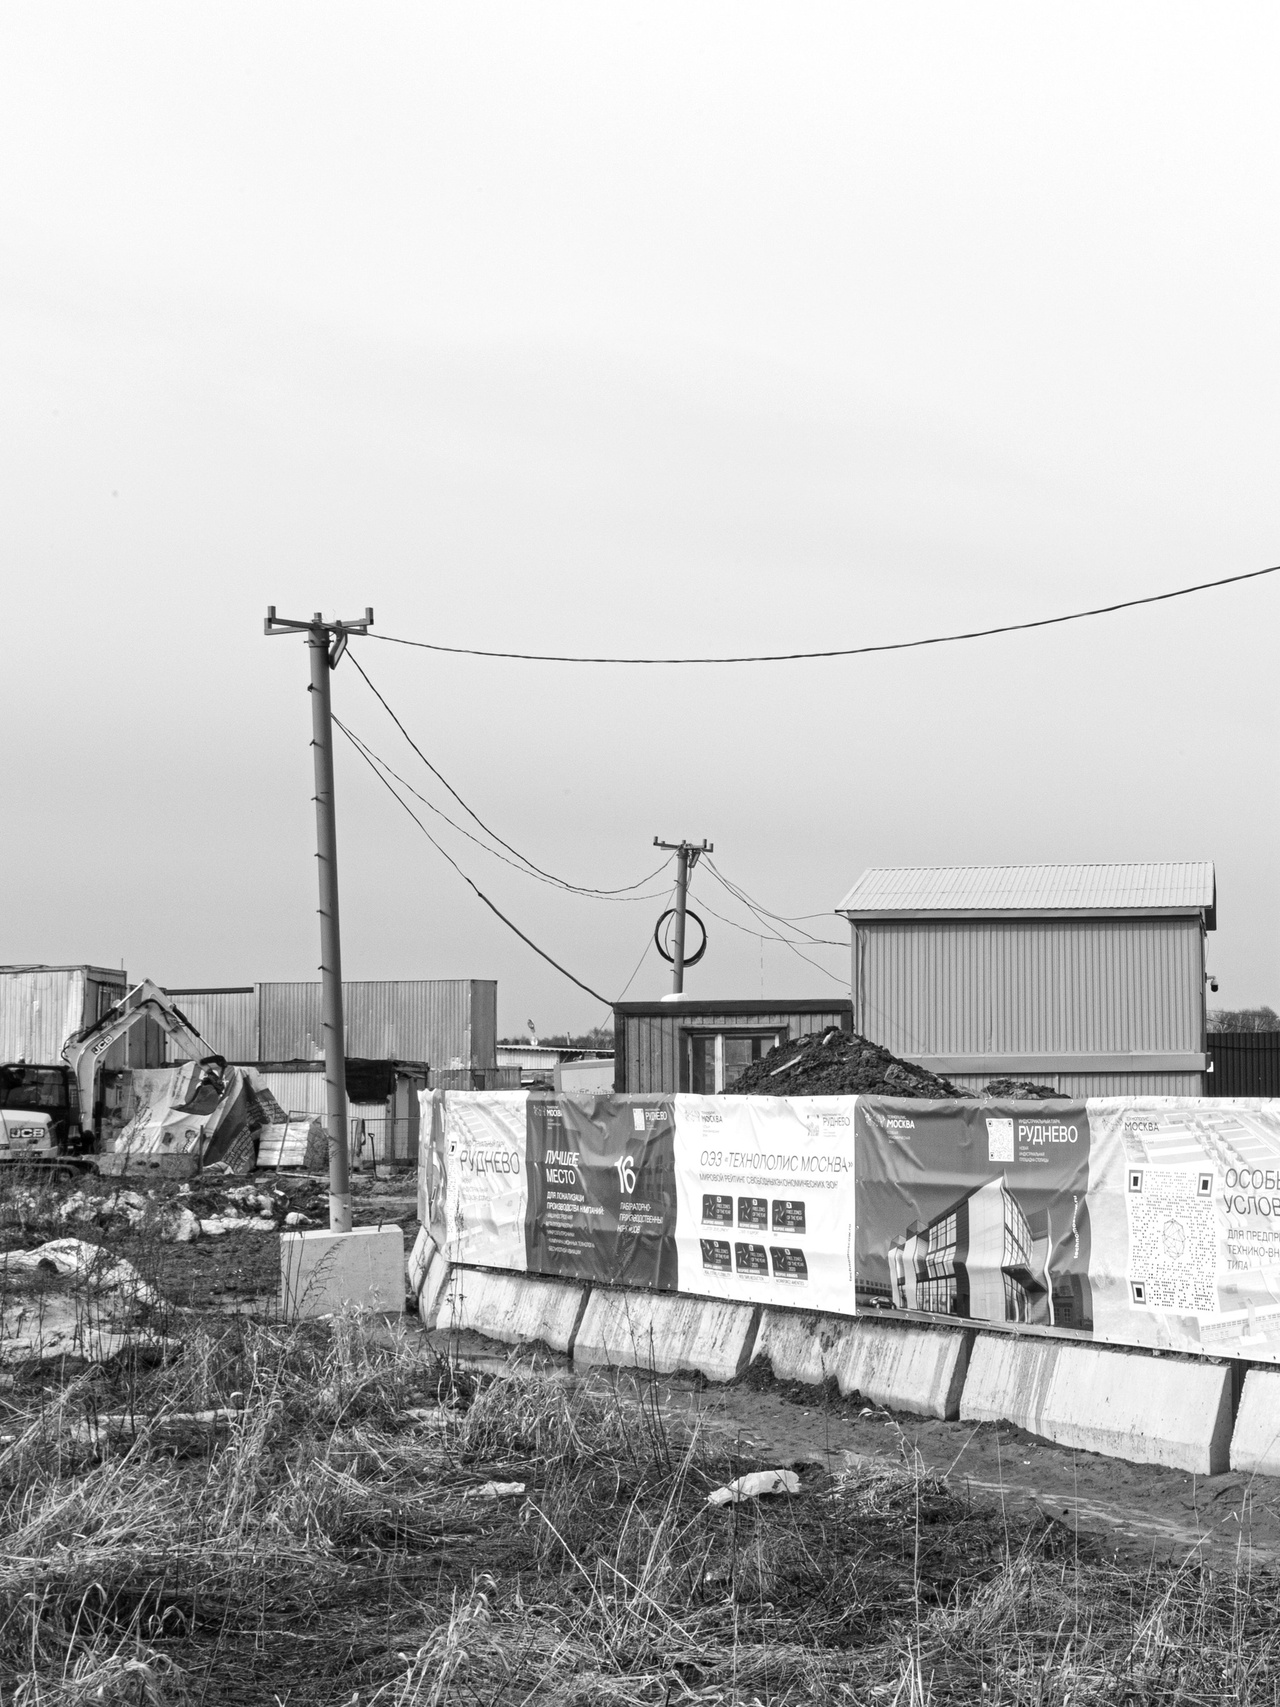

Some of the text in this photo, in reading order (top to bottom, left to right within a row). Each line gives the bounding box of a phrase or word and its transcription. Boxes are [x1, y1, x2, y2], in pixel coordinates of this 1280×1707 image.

[93, 1035, 113, 1054] JCB
[886, 1119, 915, 1129] МОСКВА
[1124, 1121, 1160, 1131] МОСКВА
[11, 1128, 45, 1138] JCB
[1018, 1125, 1078, 1146] РУДНЕВО
[460, 1150, 520, 1176] РУДНЕВО
[700, 1151, 723, 1167] ОЭЗ
[546, 1168, 576, 1185] МЕСТО
[614, 1155, 636, 1194] 16
[1227, 1229, 1245, 1240] ДЛЯ
[1227, 1259, 1249, 1271] ТИПА
